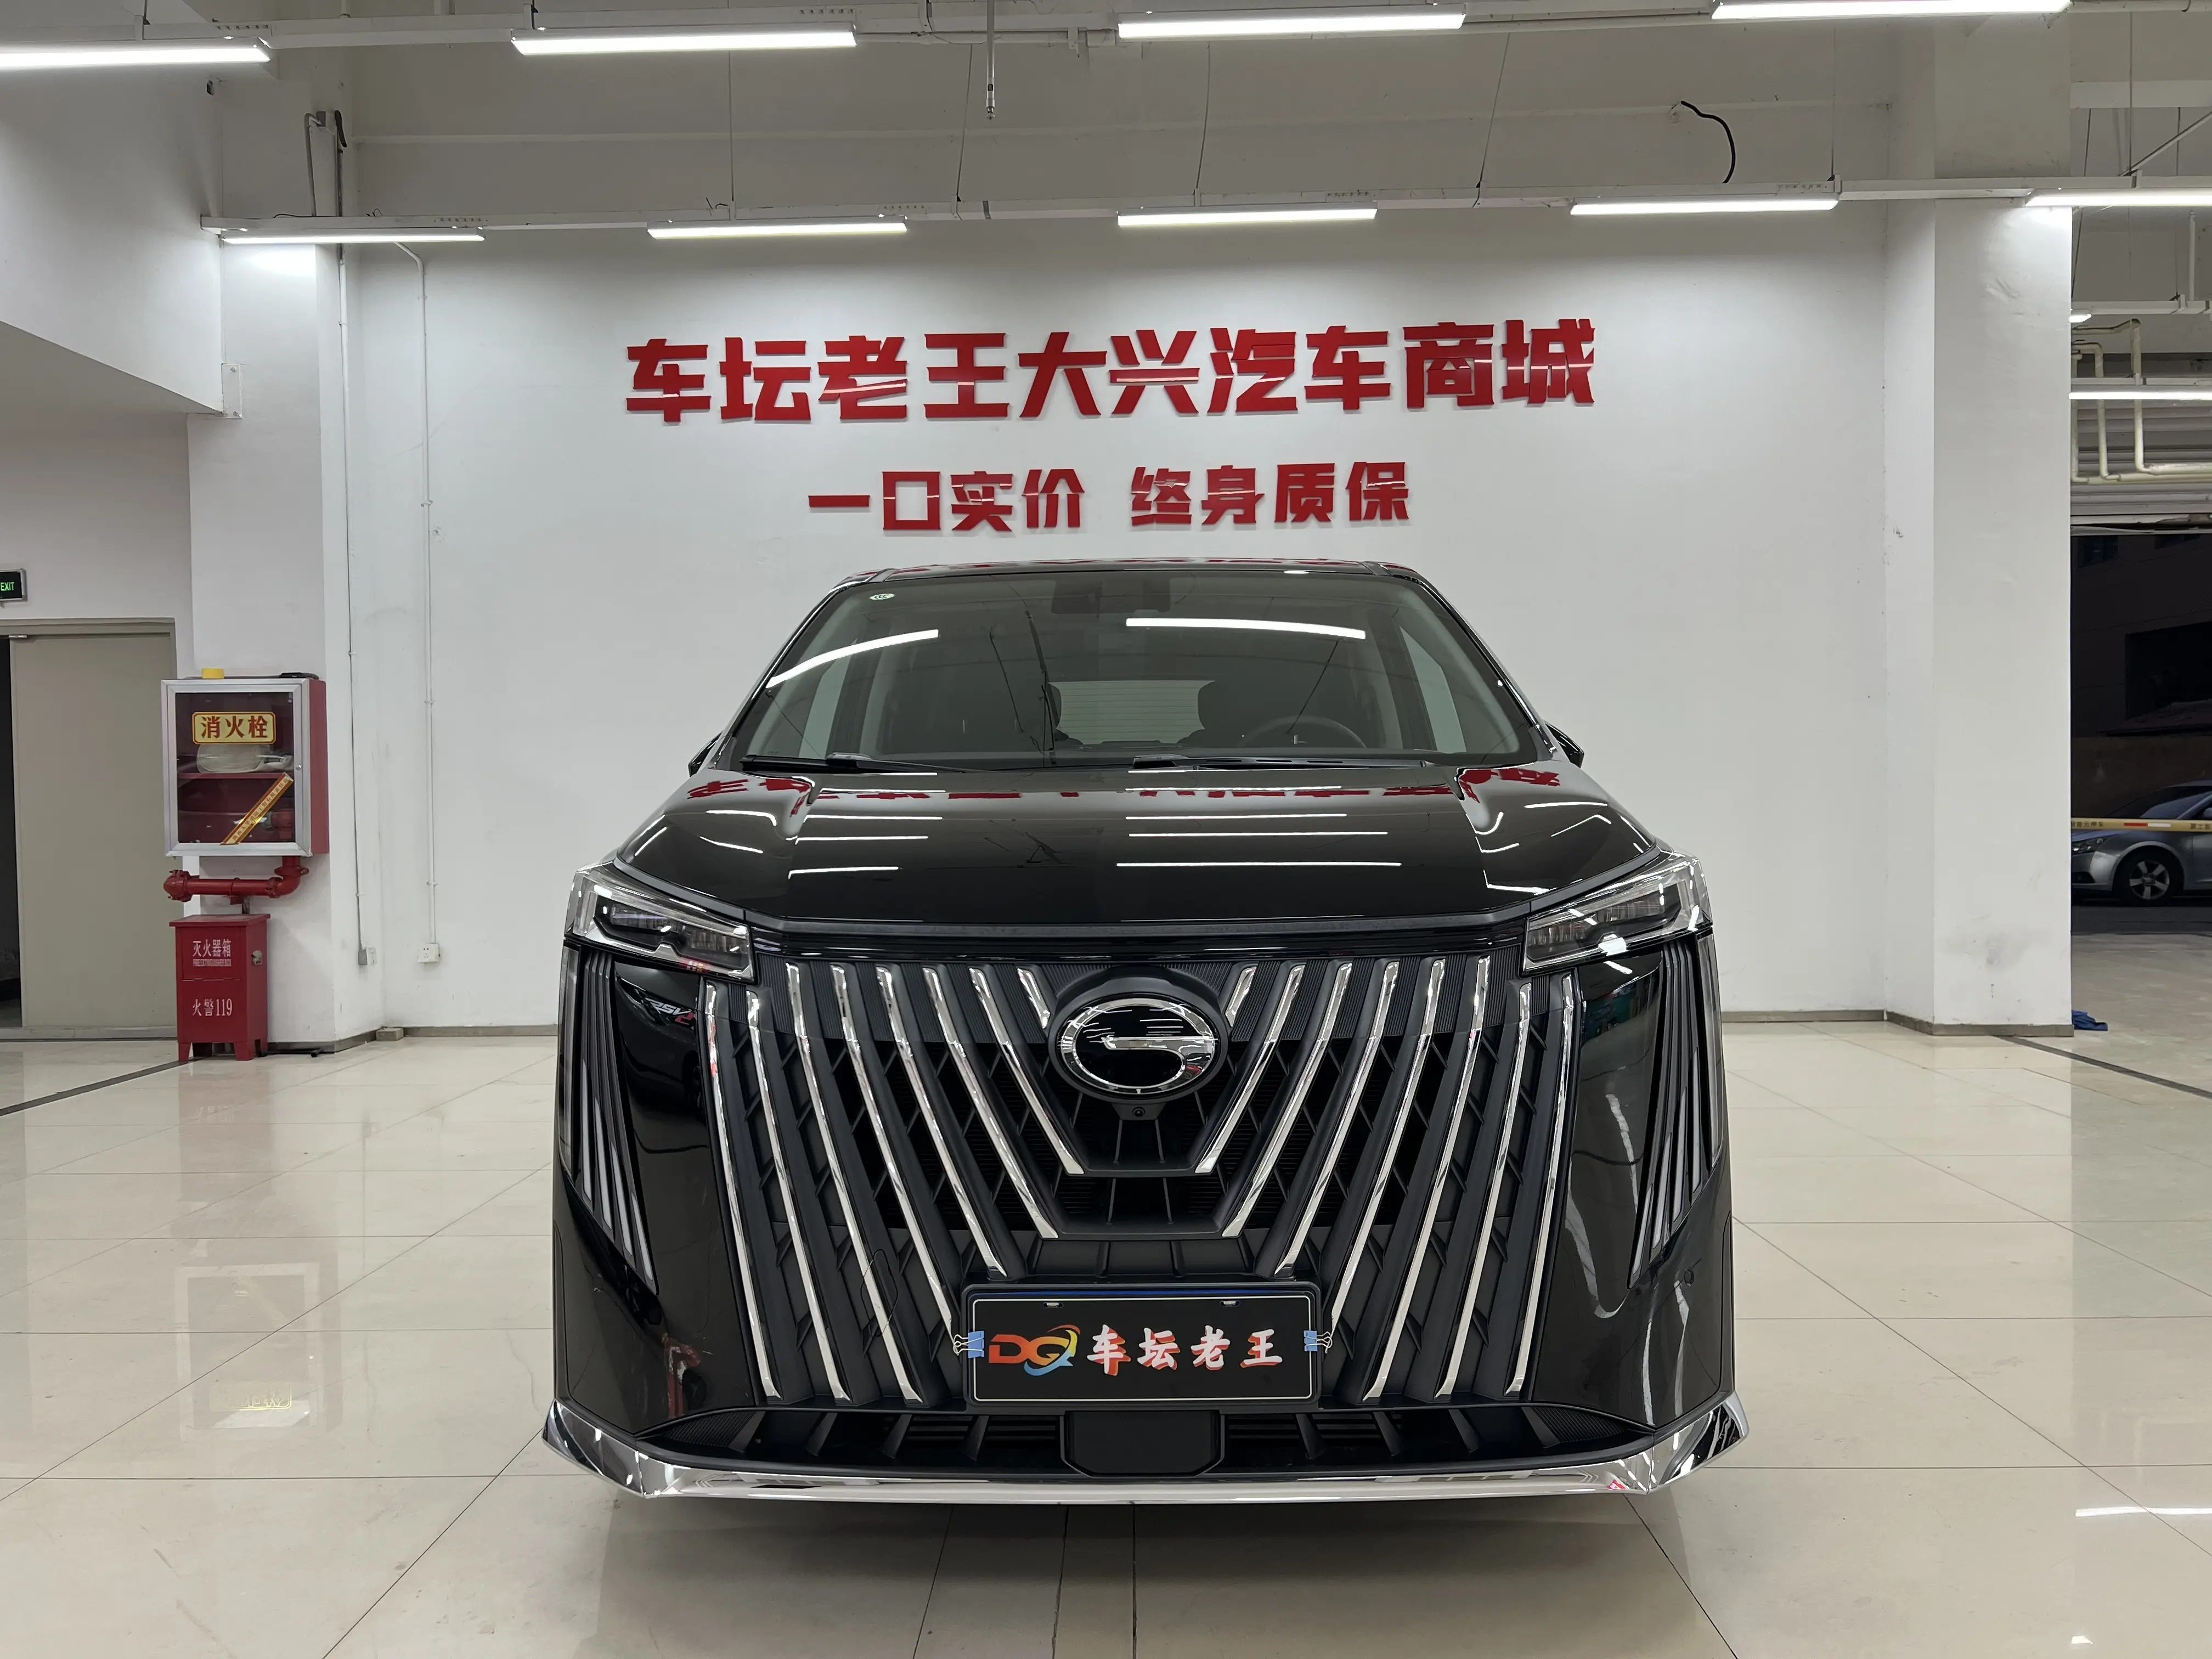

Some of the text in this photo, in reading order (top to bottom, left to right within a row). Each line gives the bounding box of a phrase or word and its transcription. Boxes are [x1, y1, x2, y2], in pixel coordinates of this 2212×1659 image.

[627, 319, 1595, 422] 车坛老王大兴汽车商城
[808, 461, 1410, 532] 一口实价 终身质保
[1, 582, 15, 591] EXIT
[201, 715, 268, 738] 消火栓
[193, 939, 231, 957] 灭火器箱
[193, 998, 233, 1016] 火警119
[1087, 1324, 1283, 1376] 车坛老王
